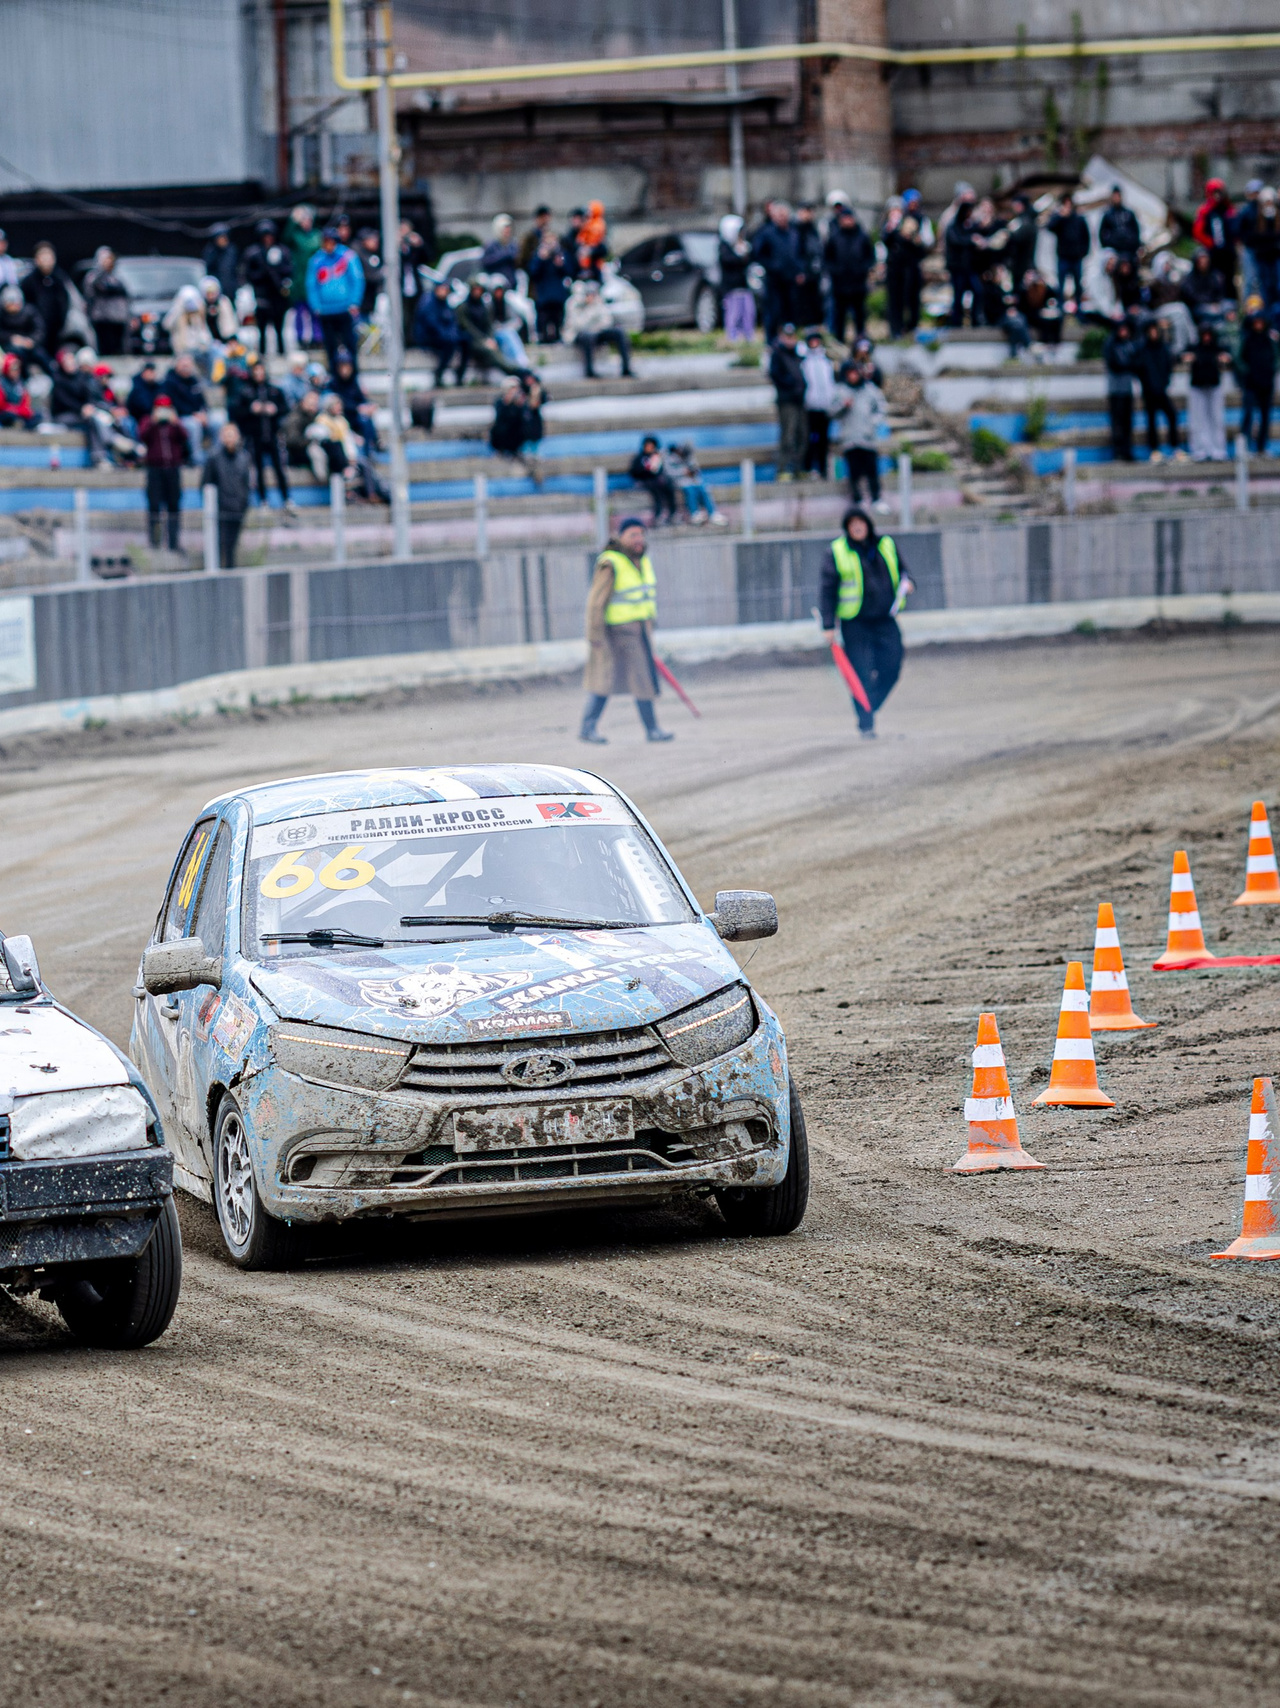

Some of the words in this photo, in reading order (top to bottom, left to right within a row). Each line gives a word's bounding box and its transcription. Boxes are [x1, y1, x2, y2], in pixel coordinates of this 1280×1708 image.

[328, 831, 388, 841] ЧЕМПИОНАТ
[391, 828, 425, 836] КУБОК
[426, 822, 491, 833] ПЕРВЕНСТВО
[493, 818, 533, 827] РОССИИ
[351, 807, 506, 832] РАЛЛИ-КРОСС
[260, 846, 376, 898] 66
[601, 949, 704, 972] TYRES
[477, 1013, 563, 1030] KRAMAR
